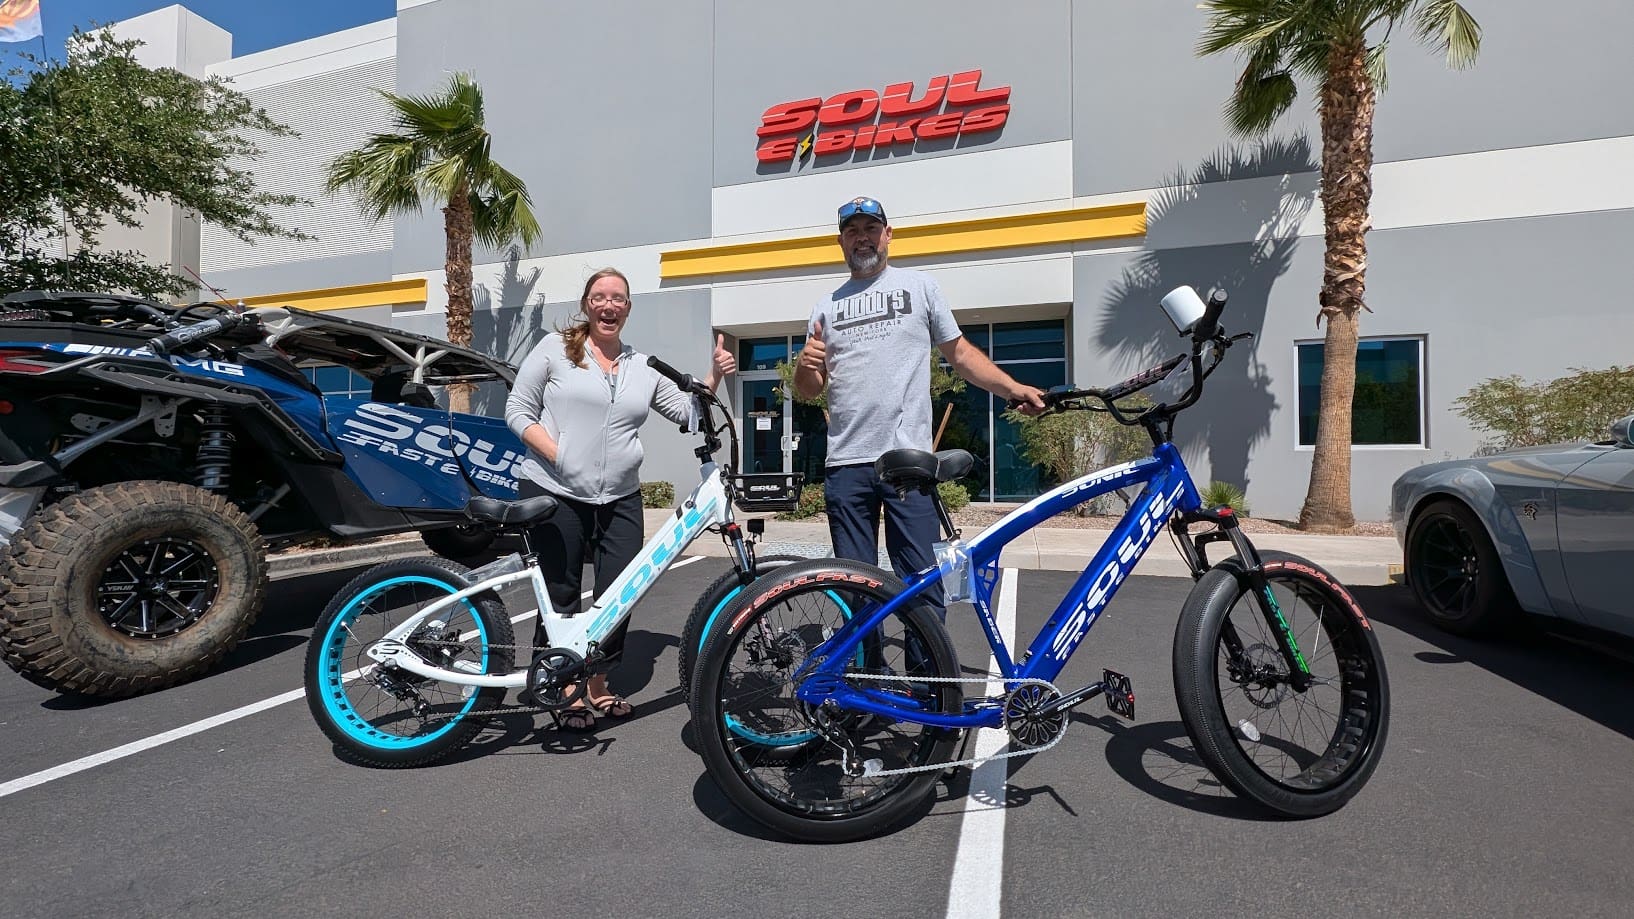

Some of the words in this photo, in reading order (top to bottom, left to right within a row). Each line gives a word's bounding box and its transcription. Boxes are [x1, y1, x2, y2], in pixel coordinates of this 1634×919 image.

[757, 69, 1011, 137] SOUL
[814, 104, 1011, 156] BIKES
[841, 326, 865, 337] AUTO
[869, 319, 902, 330] REPAIR
[337, 431, 443, 467] FAST
[585, 496, 717, 641] SOUL
[753, 575, 815, 610] SOUL
[815, 570, 884, 589] FAST
[1052, 480, 1184, 661] SOUL
[1056, 696, 1084, 712] SOUL
